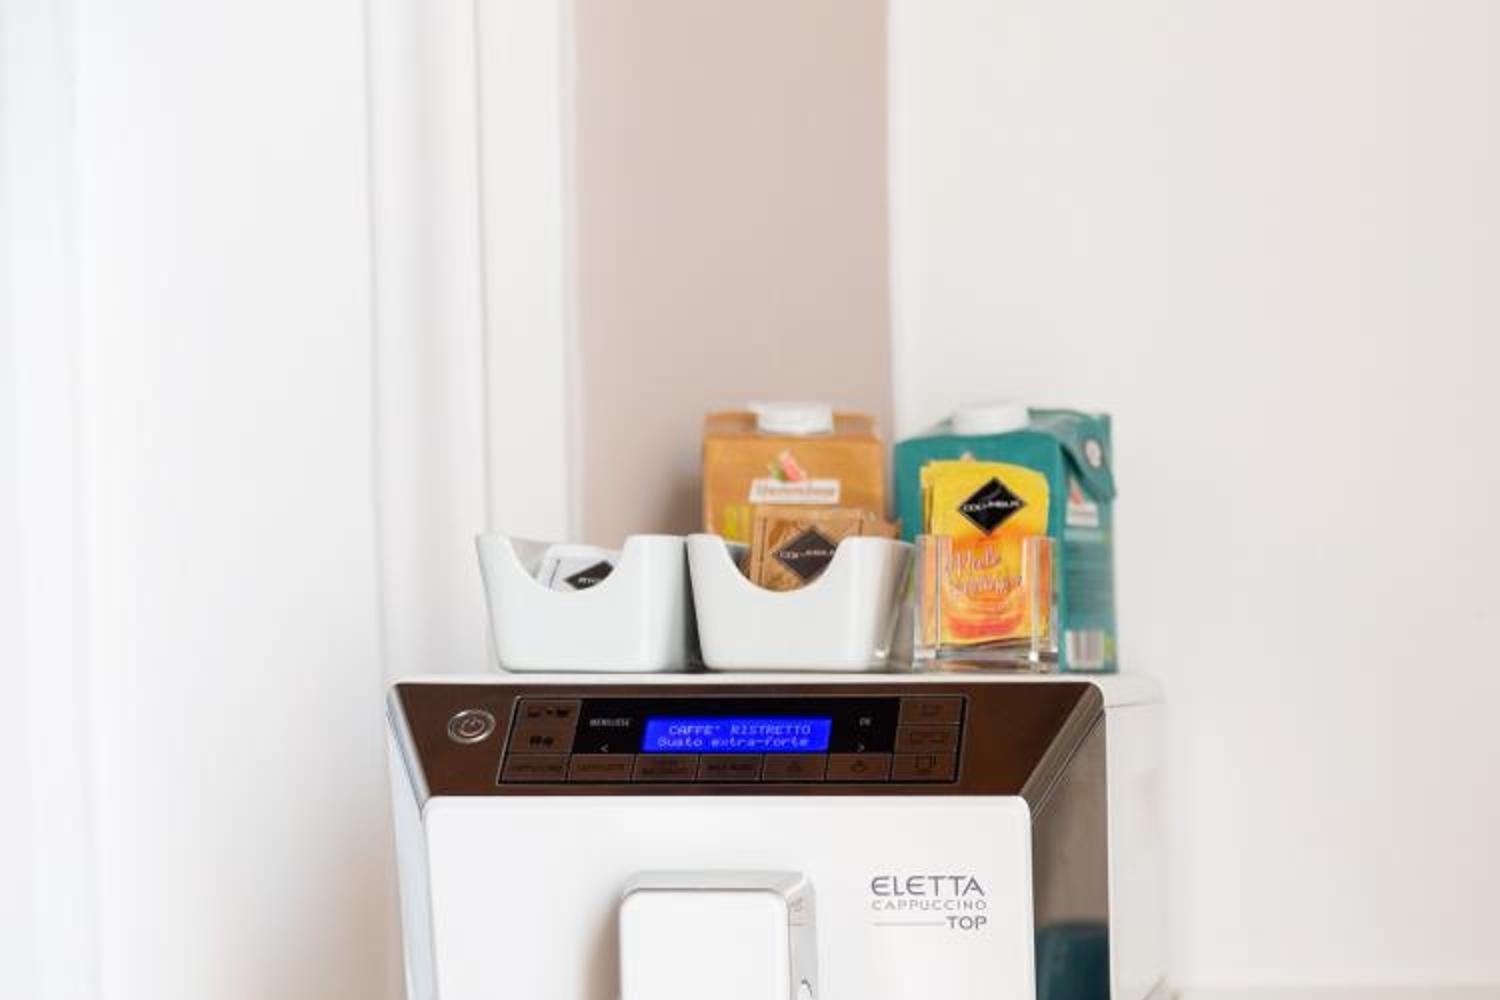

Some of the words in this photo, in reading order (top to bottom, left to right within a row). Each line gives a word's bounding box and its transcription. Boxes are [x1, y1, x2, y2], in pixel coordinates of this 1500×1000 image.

[730, 723, 812, 736] RISTRETTO
[657, 735, 703, 748] Gusto
[711, 734, 810, 748] extra-forte
[871, 875, 985, 897] ELETTA
[871, 899, 987, 911] CAPPUCCINO
[945, 915, 987, 930] TOP
